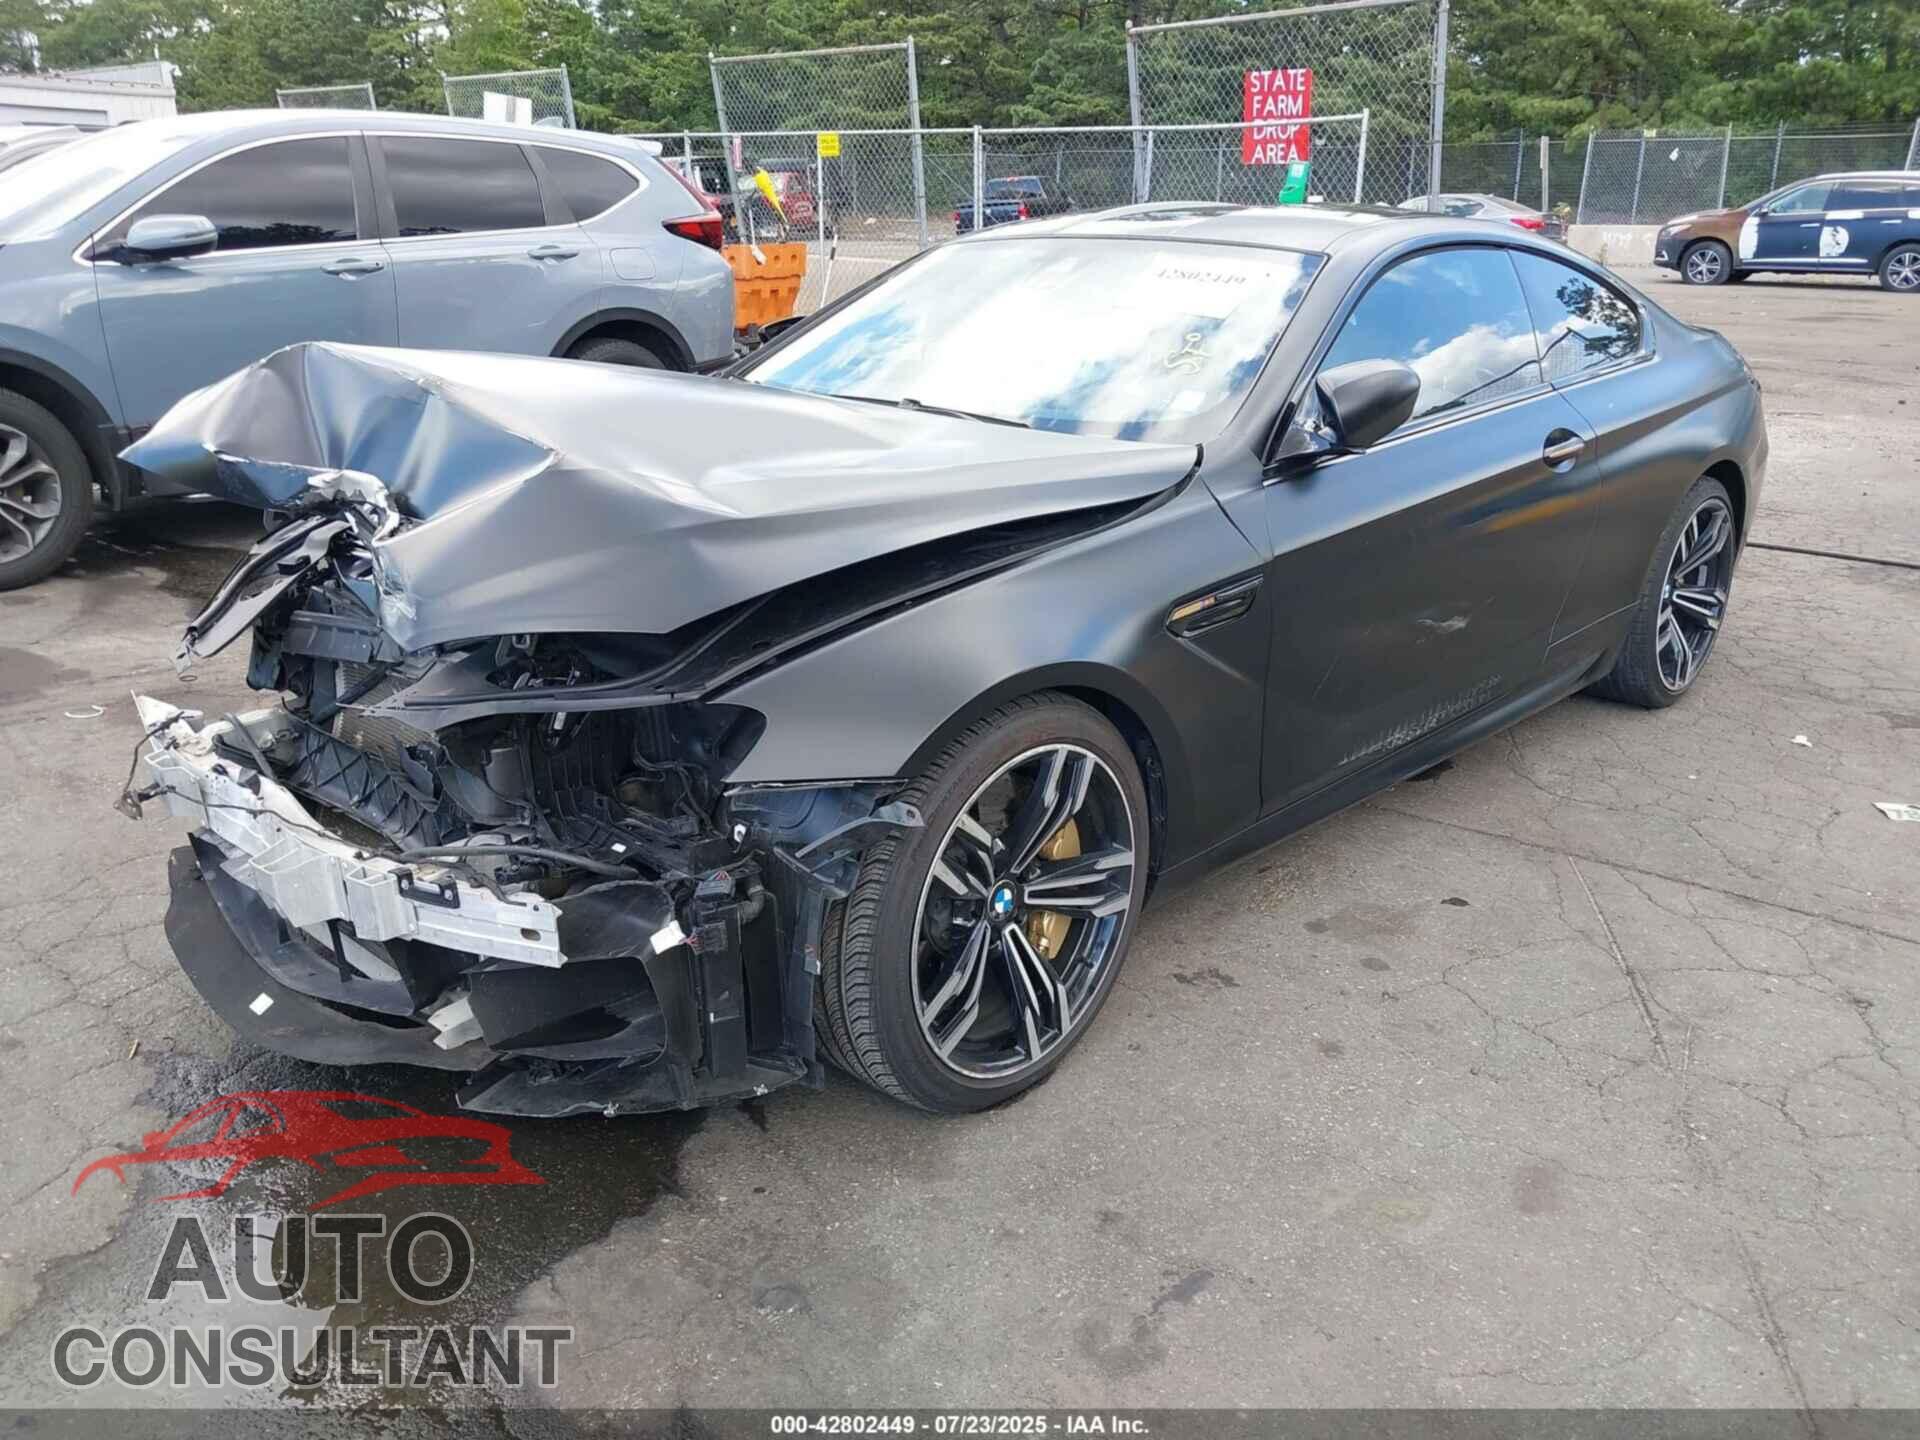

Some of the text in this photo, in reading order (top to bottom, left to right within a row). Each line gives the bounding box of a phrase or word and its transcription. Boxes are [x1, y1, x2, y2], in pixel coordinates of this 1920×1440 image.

[1250, 69, 1307, 92] STATE
[1252, 94, 1303, 117] FARM
[1253, 118, 1300, 140] DROP
[1250, 143, 1300, 165] AREA
